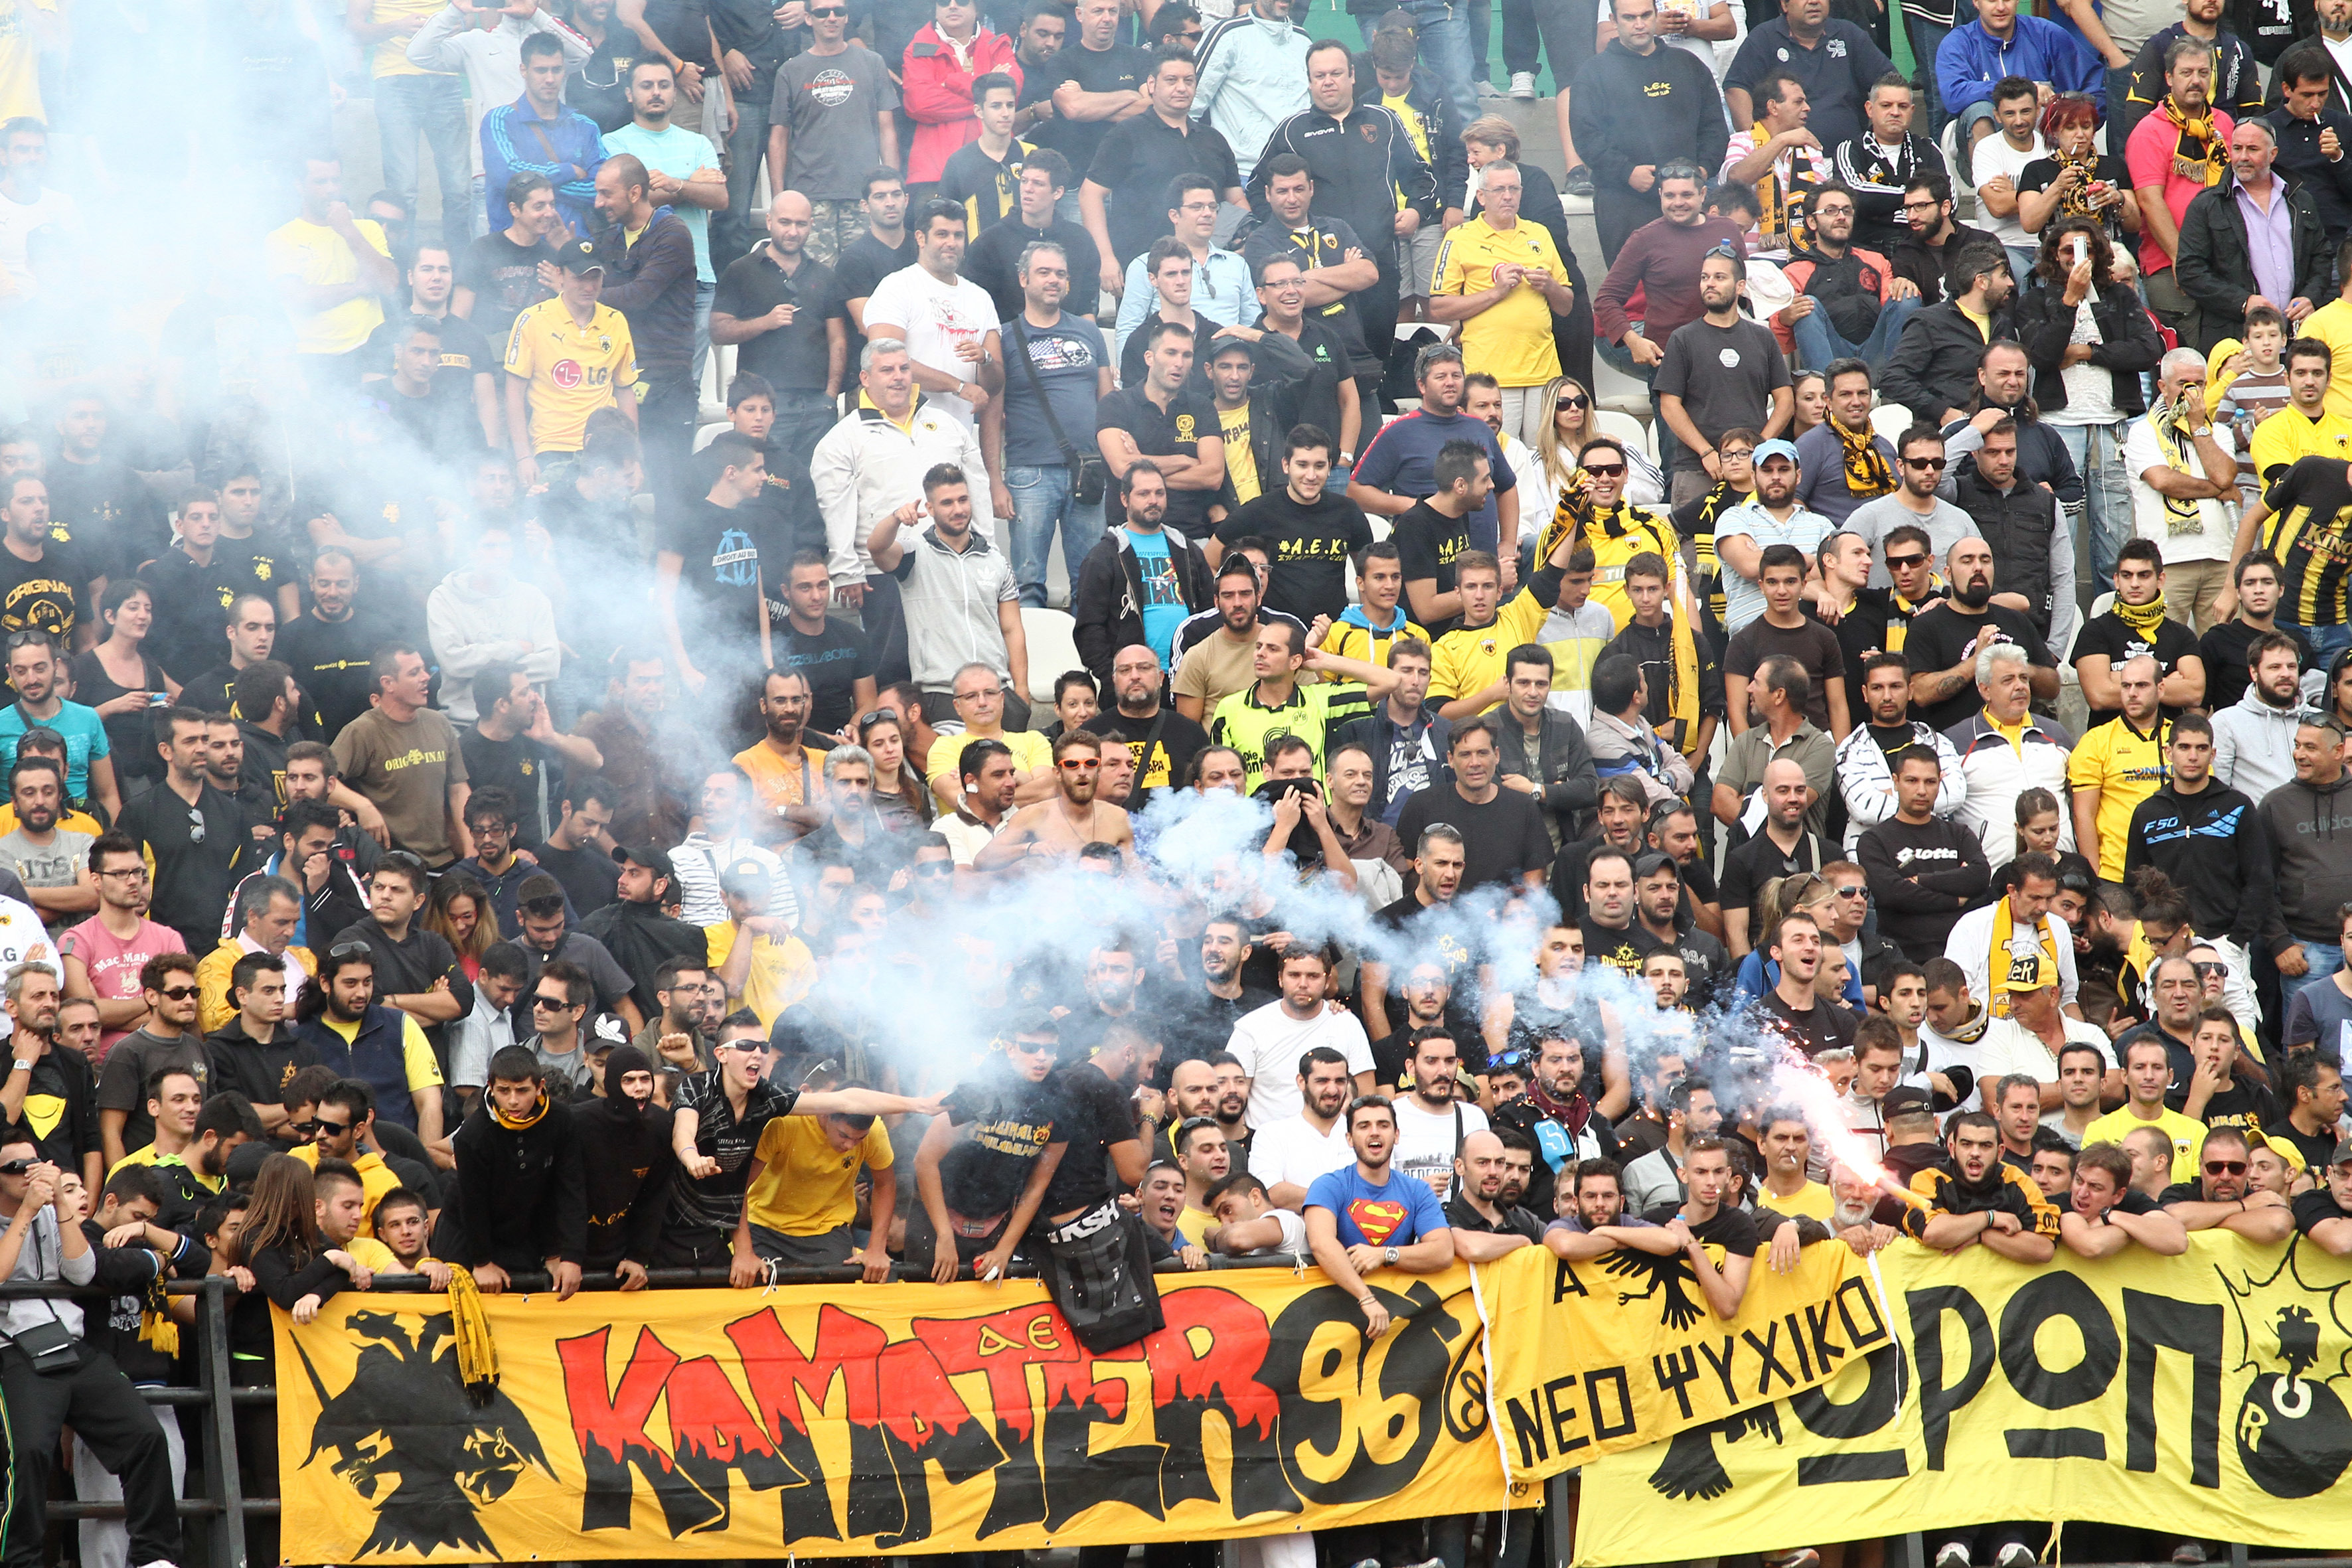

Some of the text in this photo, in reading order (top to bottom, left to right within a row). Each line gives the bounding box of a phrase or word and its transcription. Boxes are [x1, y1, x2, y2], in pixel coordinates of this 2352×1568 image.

[1304, 127, 1335, 138] GIVOVA
[588, 366, 607, 386] LG
[2303, 522, 2352, 556] KINO
[717, 552, 737, 563] DROIT
[2297, 814, 2352, 834] adida
[0, 947, 17, 962] G
[94, 952, 149, 973] Mac Mah
[1680, 948, 1709, 971] 994
[1036, 1131, 1050, 1142] 21
[1653, 1275, 1888, 1419] ΨΥΧΙΚΟ
[1294, 1317, 1421, 1484] 96
